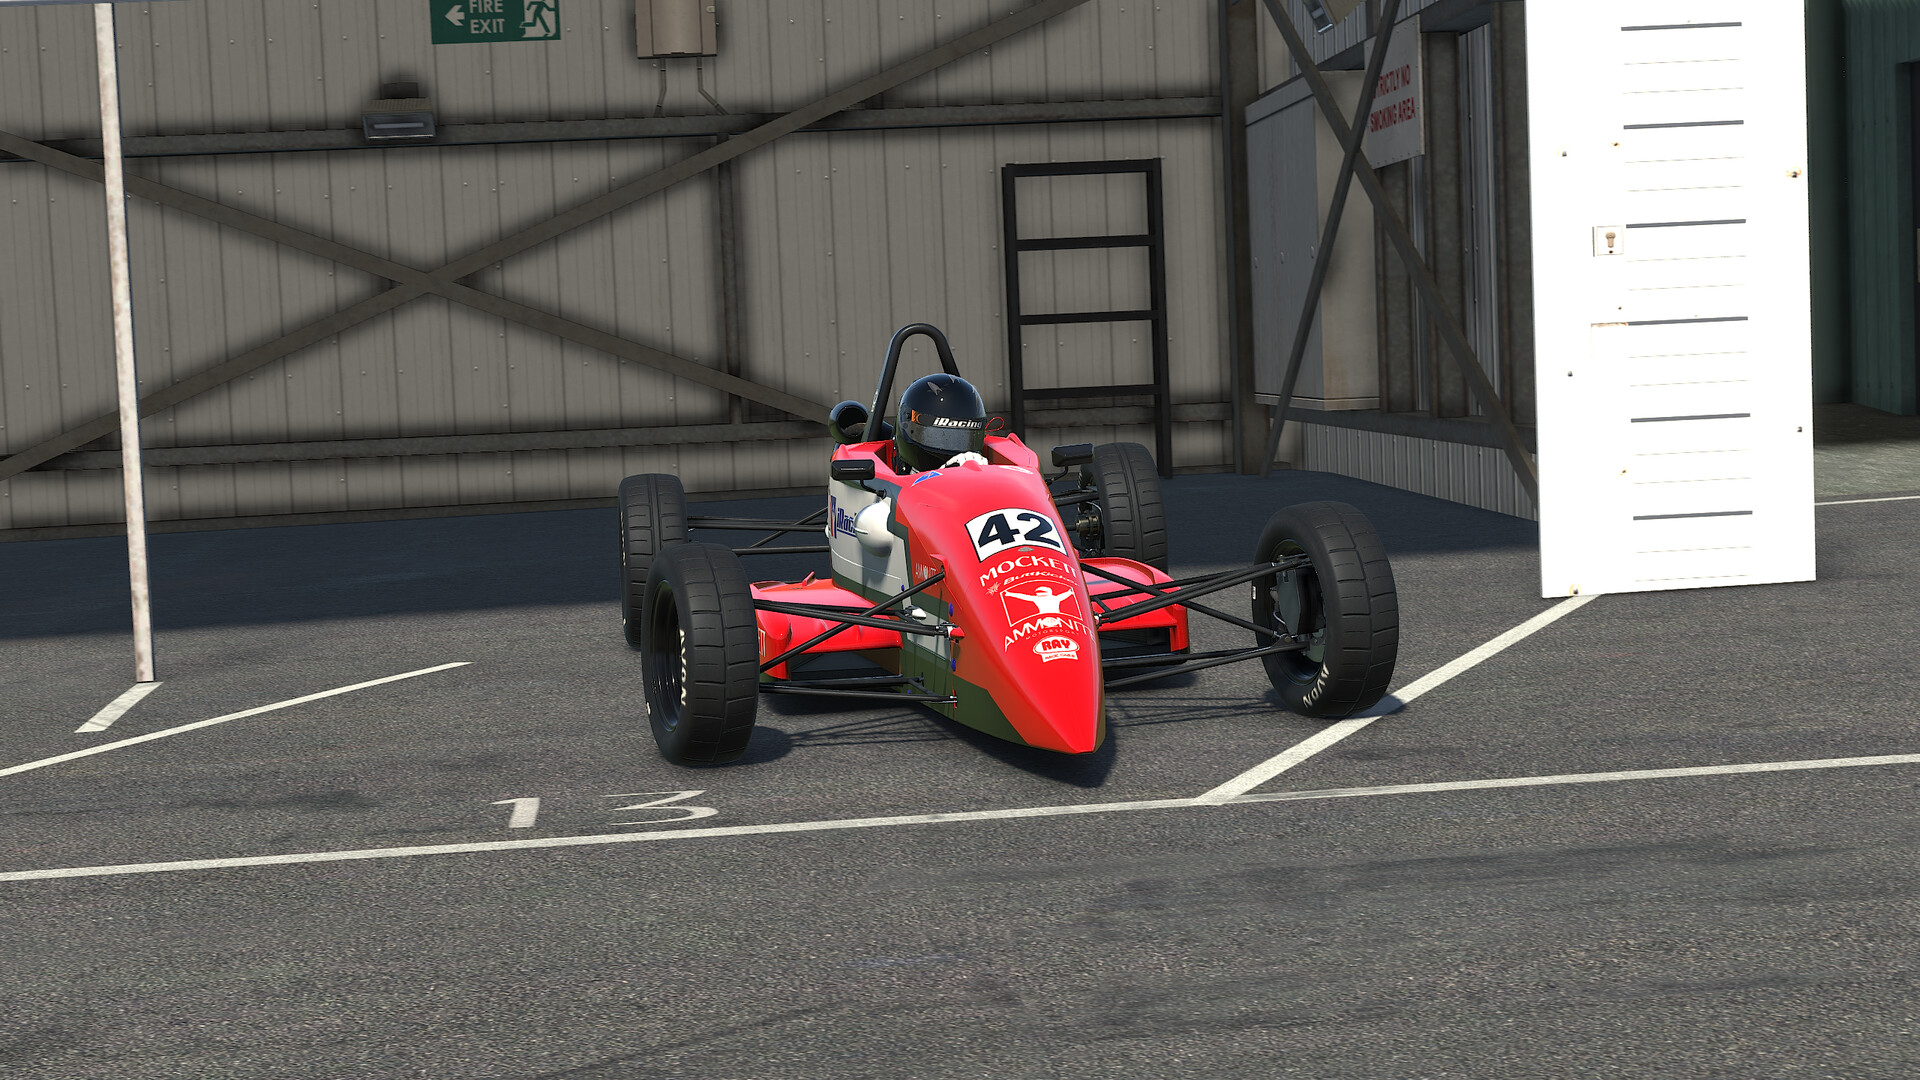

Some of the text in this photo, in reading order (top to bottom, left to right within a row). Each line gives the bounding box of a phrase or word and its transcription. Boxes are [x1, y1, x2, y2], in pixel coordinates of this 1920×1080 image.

[469, 0, 504, 13] FIRE
[470, 18, 505, 34] EXIT
[1373, 63, 1411, 99] RICTLY NO
[1370, 96, 1416, 133] SMOKING AREA
[932, 416, 983, 430] iRacing
[977, 512, 1061, 549] 42
[980, 555, 1077, 587] MOCKETT
[1041, 638, 1071, 652] RAY
[1302, 661, 1330, 709] AVON
